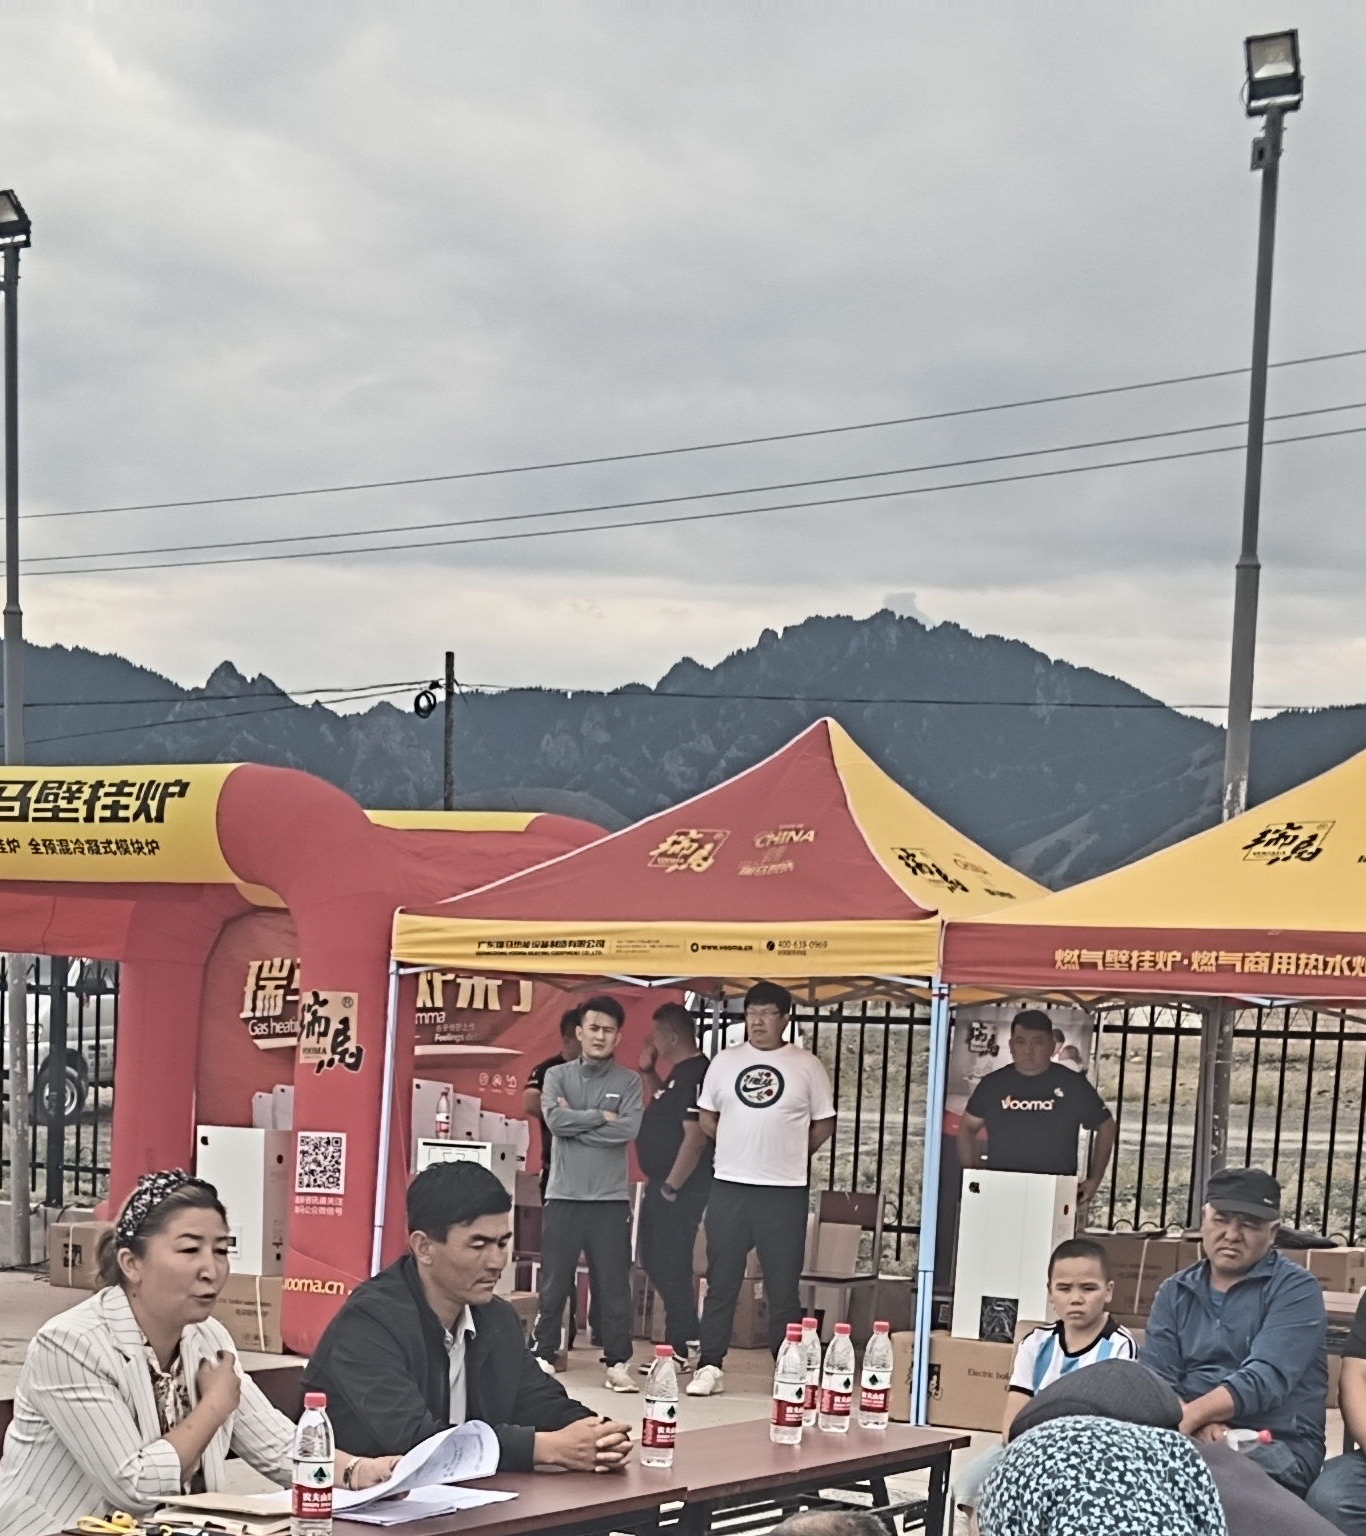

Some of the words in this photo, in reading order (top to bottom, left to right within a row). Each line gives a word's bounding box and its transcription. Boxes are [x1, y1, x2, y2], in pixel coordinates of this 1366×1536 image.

[28, 838, 160, 857] 全预混冷凝式模块炉
[754, 830, 815, 848] CHINA
[249, 1020, 269, 1036] Gas
[968, 1368, 994, 1378] Electric
